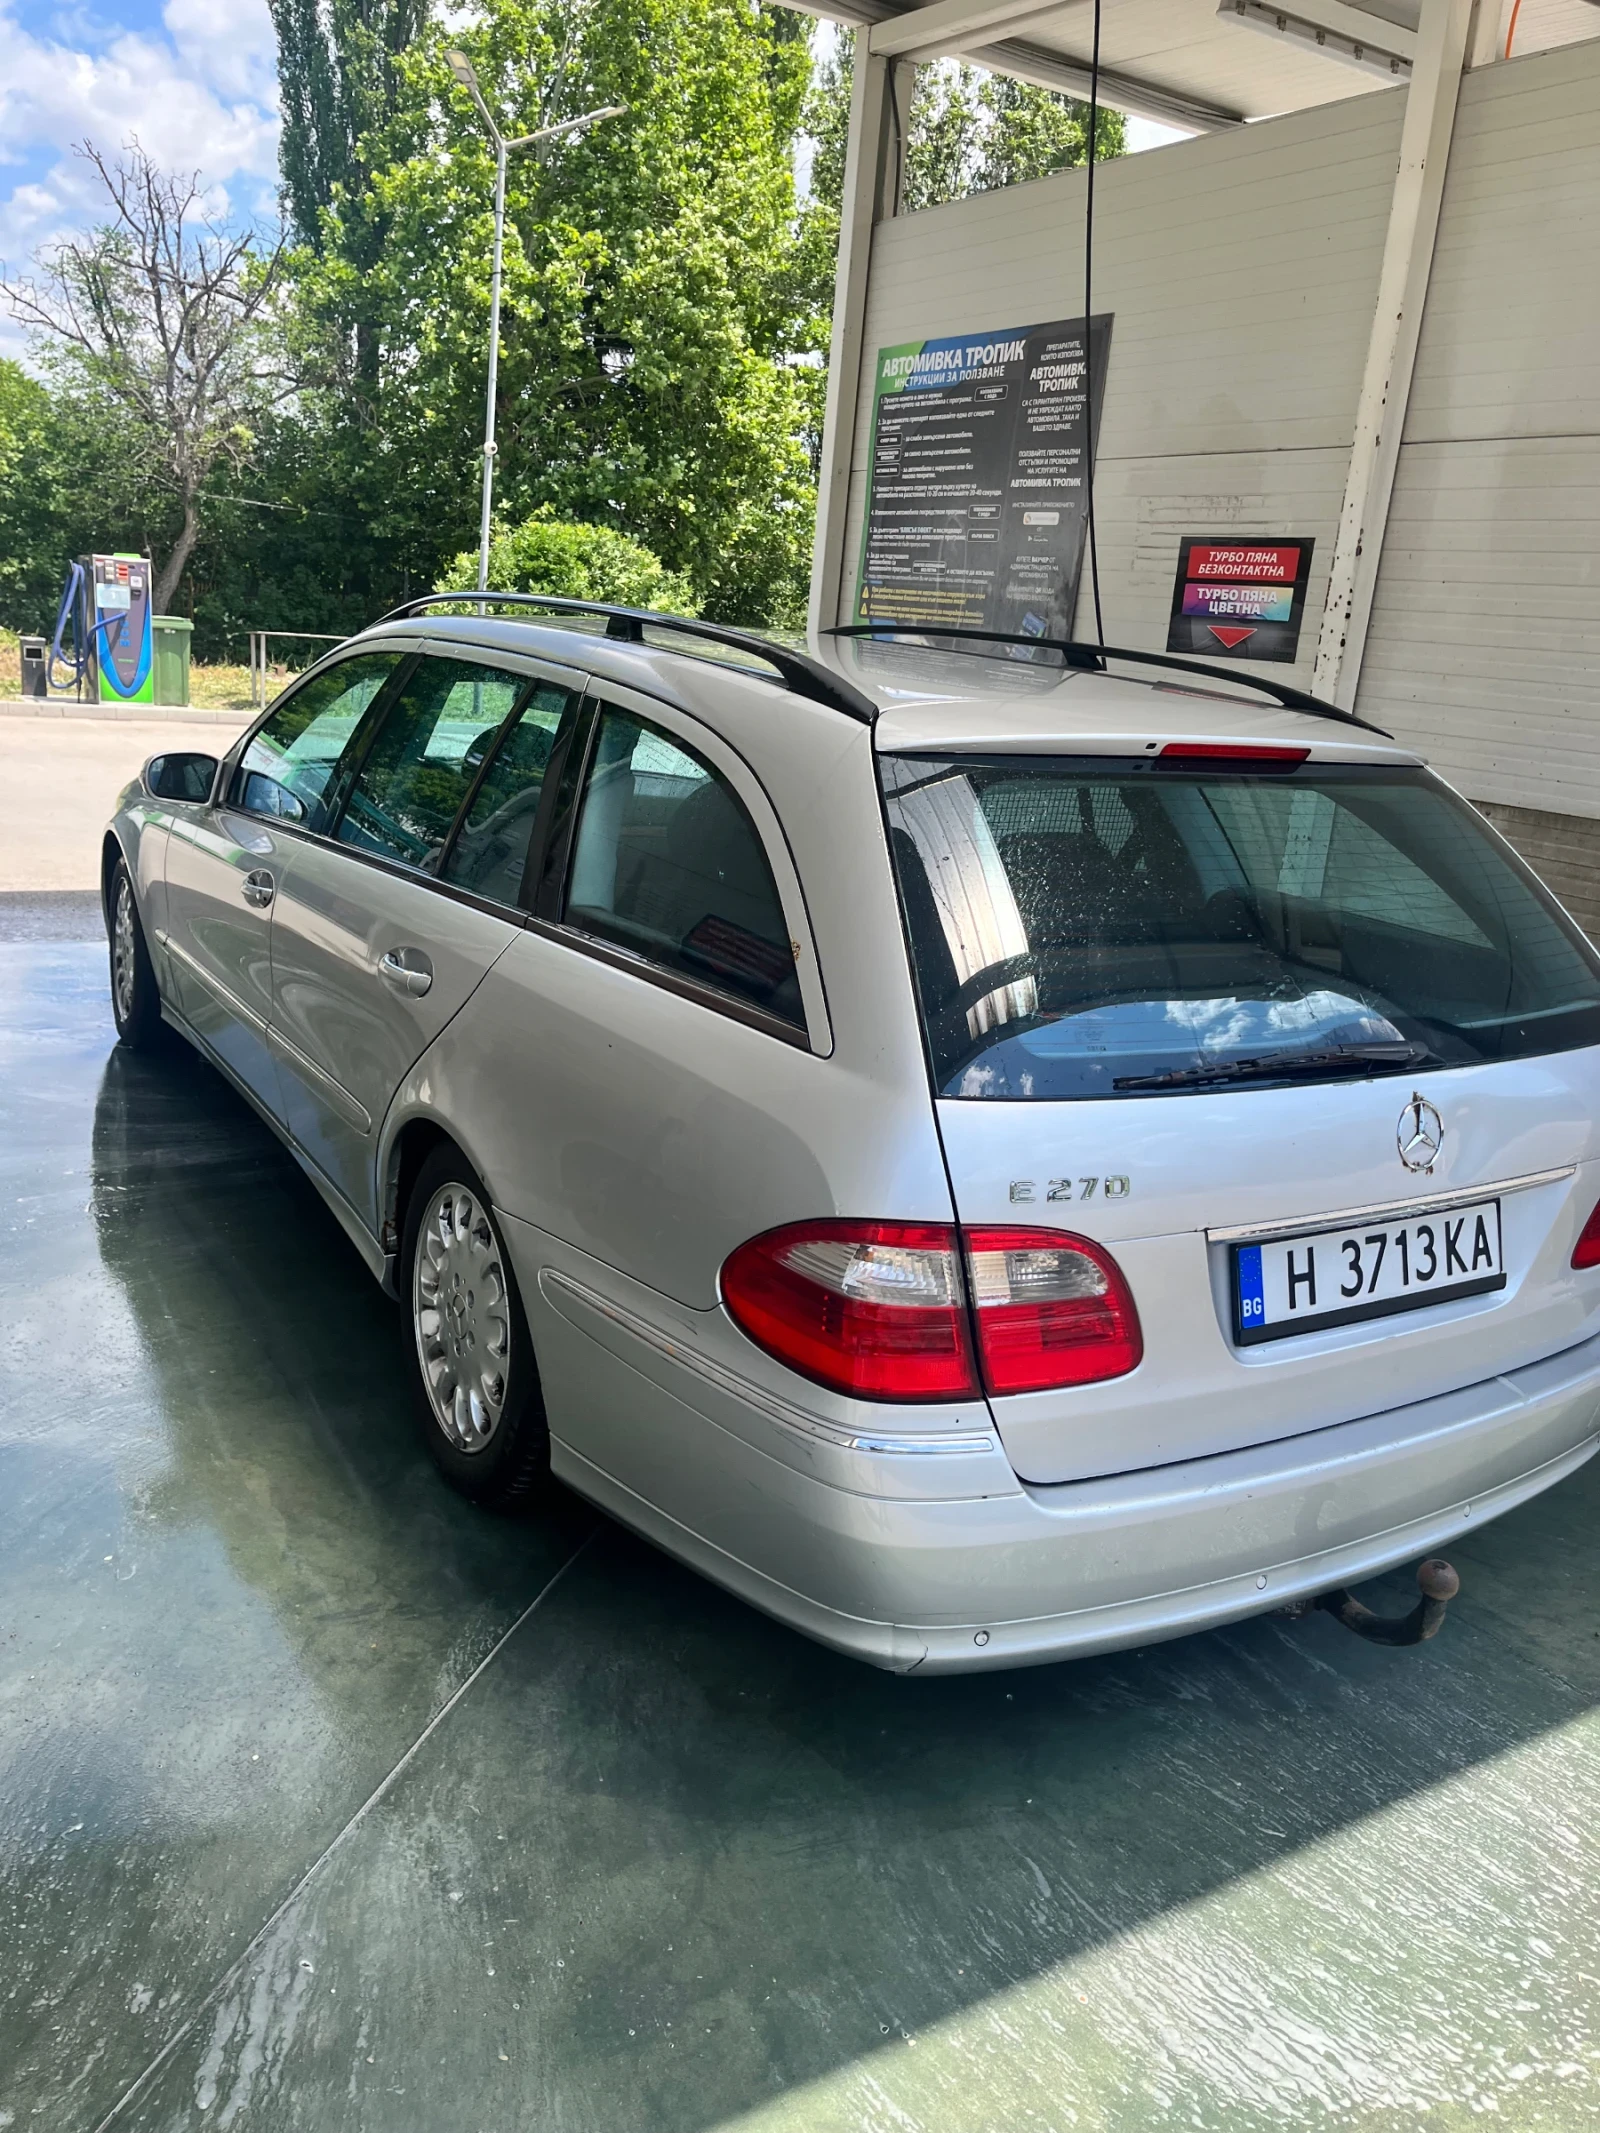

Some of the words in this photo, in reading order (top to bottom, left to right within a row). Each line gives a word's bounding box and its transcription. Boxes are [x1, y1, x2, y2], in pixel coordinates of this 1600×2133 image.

[882, 348, 963, 377] АВТОМИВКА
[966, 340, 1026, 367] ТРОПИК
[894, 373, 945, 388] ИНСТРУКЦИИ
[947, 371, 957, 382] ЗА
[959, 365, 1005, 380] ПОЛЗВАНЕ
[1039, 377, 1079, 392] ТРОПИК
[1010, 478, 1051, 487] АВТОМИВКА
[1052, 478, 1081, 487] ТРОПИК
[1209, 552, 1245, 563] ТУРБО
[1245, 552, 1277, 563] ПЯНА
[1198, 564, 1285, 576] БЕЗКОНТАКТНА
[1197, 588, 1239, 601] ТУРБО
[1240, 590, 1277, 603] ПЯНА
[1208, 601, 1261, 615] ЦВЕТНА
[1010, 1180, 1036, 1203] E
[1046, 1175, 1130, 1203] 270
[1242, 1297, 1262, 1318] BG
